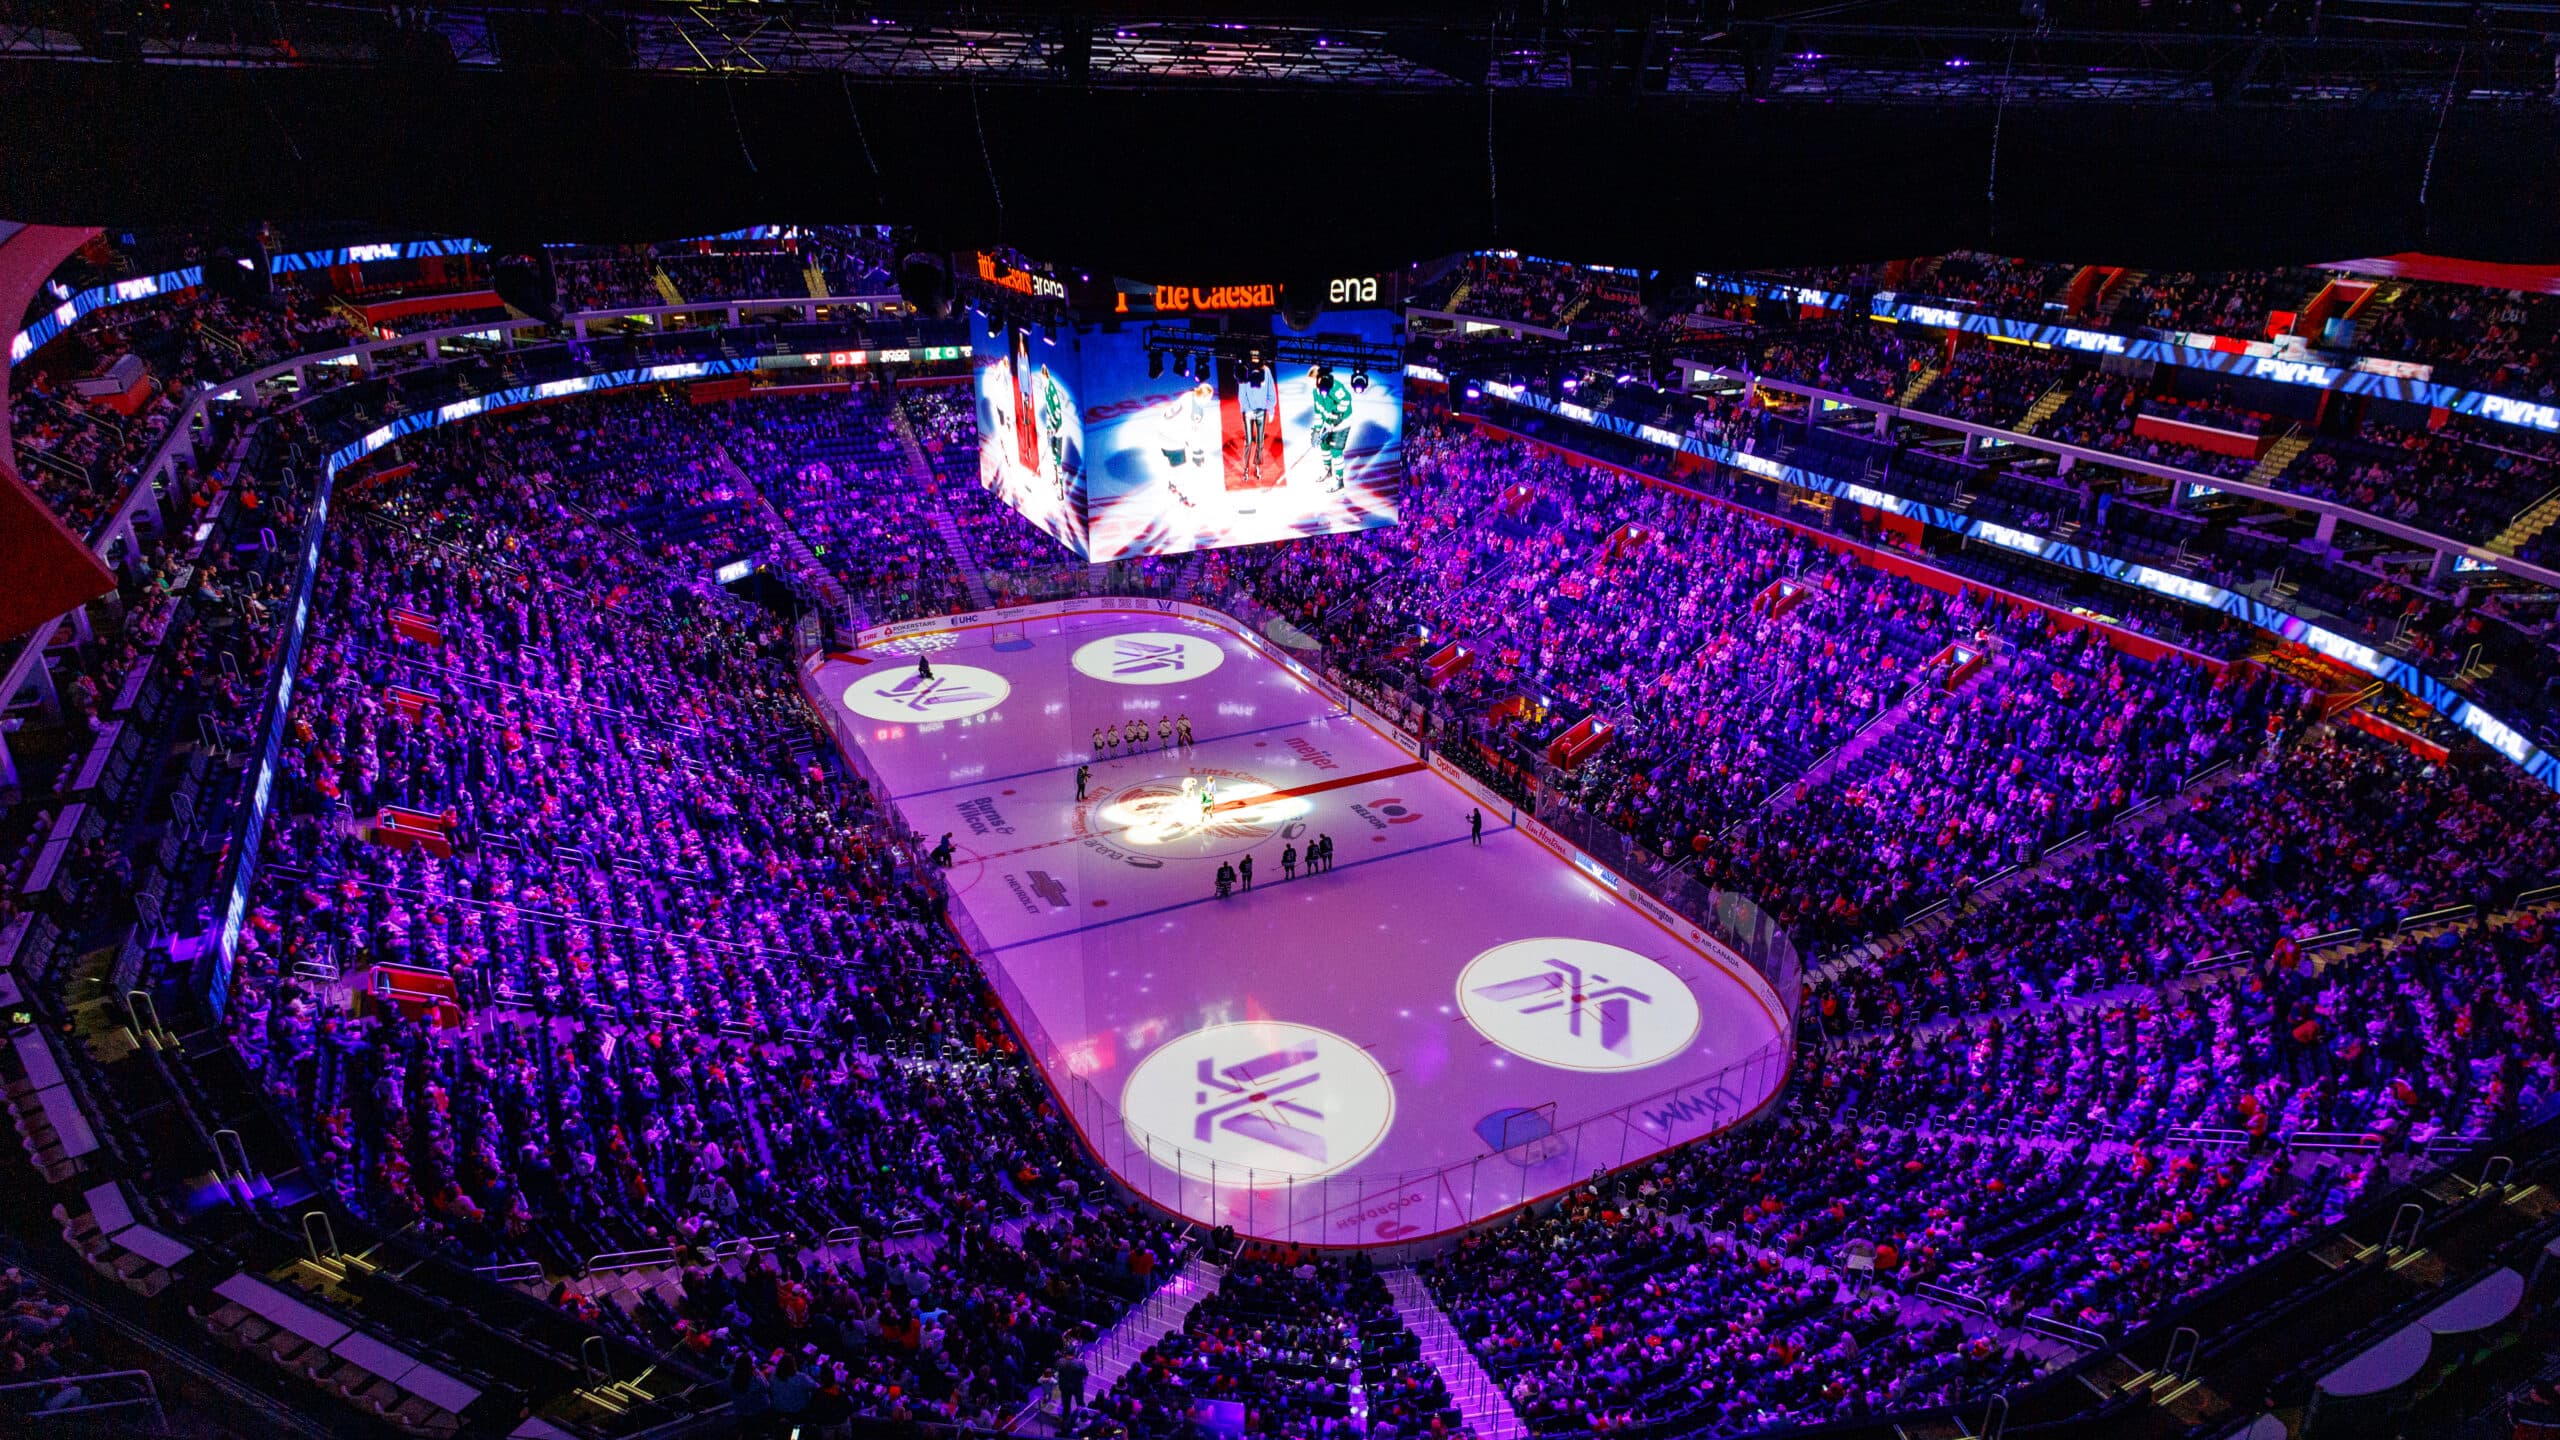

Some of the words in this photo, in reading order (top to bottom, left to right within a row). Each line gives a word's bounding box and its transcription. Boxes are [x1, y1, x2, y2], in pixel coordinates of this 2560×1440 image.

[1032, 274, 1065, 299] arena
[1329, 277, 1378, 303] ena
[1910, 306, 1961, 327] PWHL
[2065, 328, 2125, 353] PWHL
[652, 362, 702, 379] PWHL
[2255, 357, 2331, 386] PWHL
[2482, 394, 2560, 430] PWHL
[1642, 424, 1681, 449] PWHL
[1737, 451, 1782, 477] PWHL
[1849, 483, 1900, 512] PWHL
[1979, 520, 2042, 553] PWHL
[2138, 566, 2214, 605] PWHL
[893, 620, 937, 632] POKERSTARS
[959, 615, 979, 624] UHC
[2307, 624, 2379, 673] PWHL
[2463, 703, 2527, 762] PWHL
[1284, 737, 1340, 770] meijer
[1436, 756, 1461, 780] Optum
[1189, 767, 1233, 777] Little
[956, 799, 991, 836] Wilcox
[973, 796, 1006, 827] Burns
[995, 825, 1017, 836] &
[1349, 803, 1388, 830] BELFOR
[1083, 838, 1125, 861] arena
[1524, 817, 1538, 837] Tim
[1537, 827, 1567, 856] Hortons
[1003, 873, 1041, 915] CHEVROLET
[1637, 892, 1675, 926] Huntington
[1700, 938, 1713, 949] AIR
[1711, 944, 1740, 969] CANADA
[1336, 1192, 1423, 1231] DOORDASH
